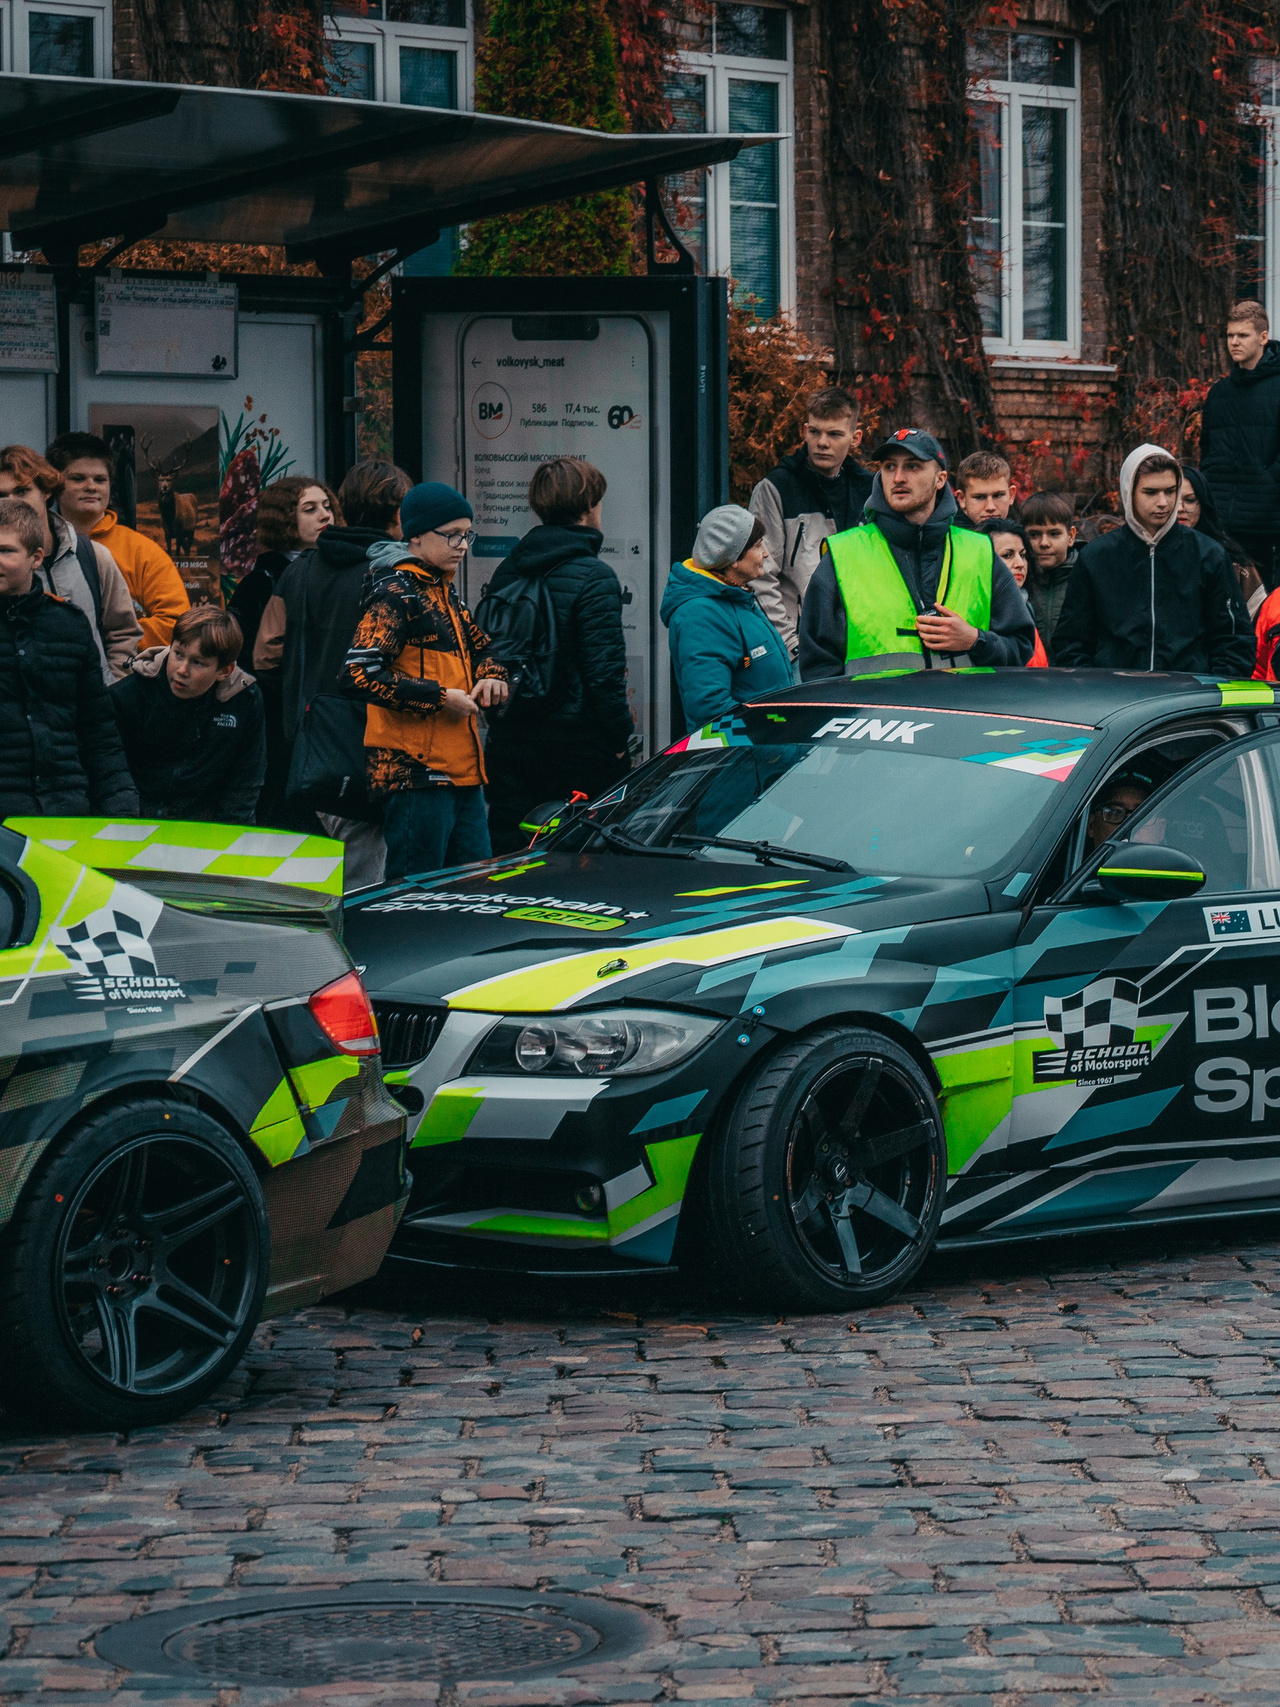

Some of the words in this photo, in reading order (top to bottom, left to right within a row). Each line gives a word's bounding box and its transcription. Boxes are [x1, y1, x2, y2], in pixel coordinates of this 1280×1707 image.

[497, 356, 565, 369] volkovysk_meat
[532, 403, 547, 413] 586
[564, 403, 581, 414] 17,4
[582, 404, 600, 414] тыс.
[520, 418, 558, 427] Публикации
[811, 717, 934, 744] FINK
[360, 901, 508, 914] Sports
[388, 892, 623, 916] Blockchain
[522, 910, 610, 926] DRIFT
[104, 977, 180, 988] SCHOOL
[109, 988, 120, 1000] of
[120, 988, 186, 1000] Motorsport
[1070, 1043, 1151, 1060] SCHOOL
[1070, 1060, 1082, 1072] of
[1085, 1056, 1149, 1071] Motorsport
[1096, 1077, 1113, 1085] 1967
